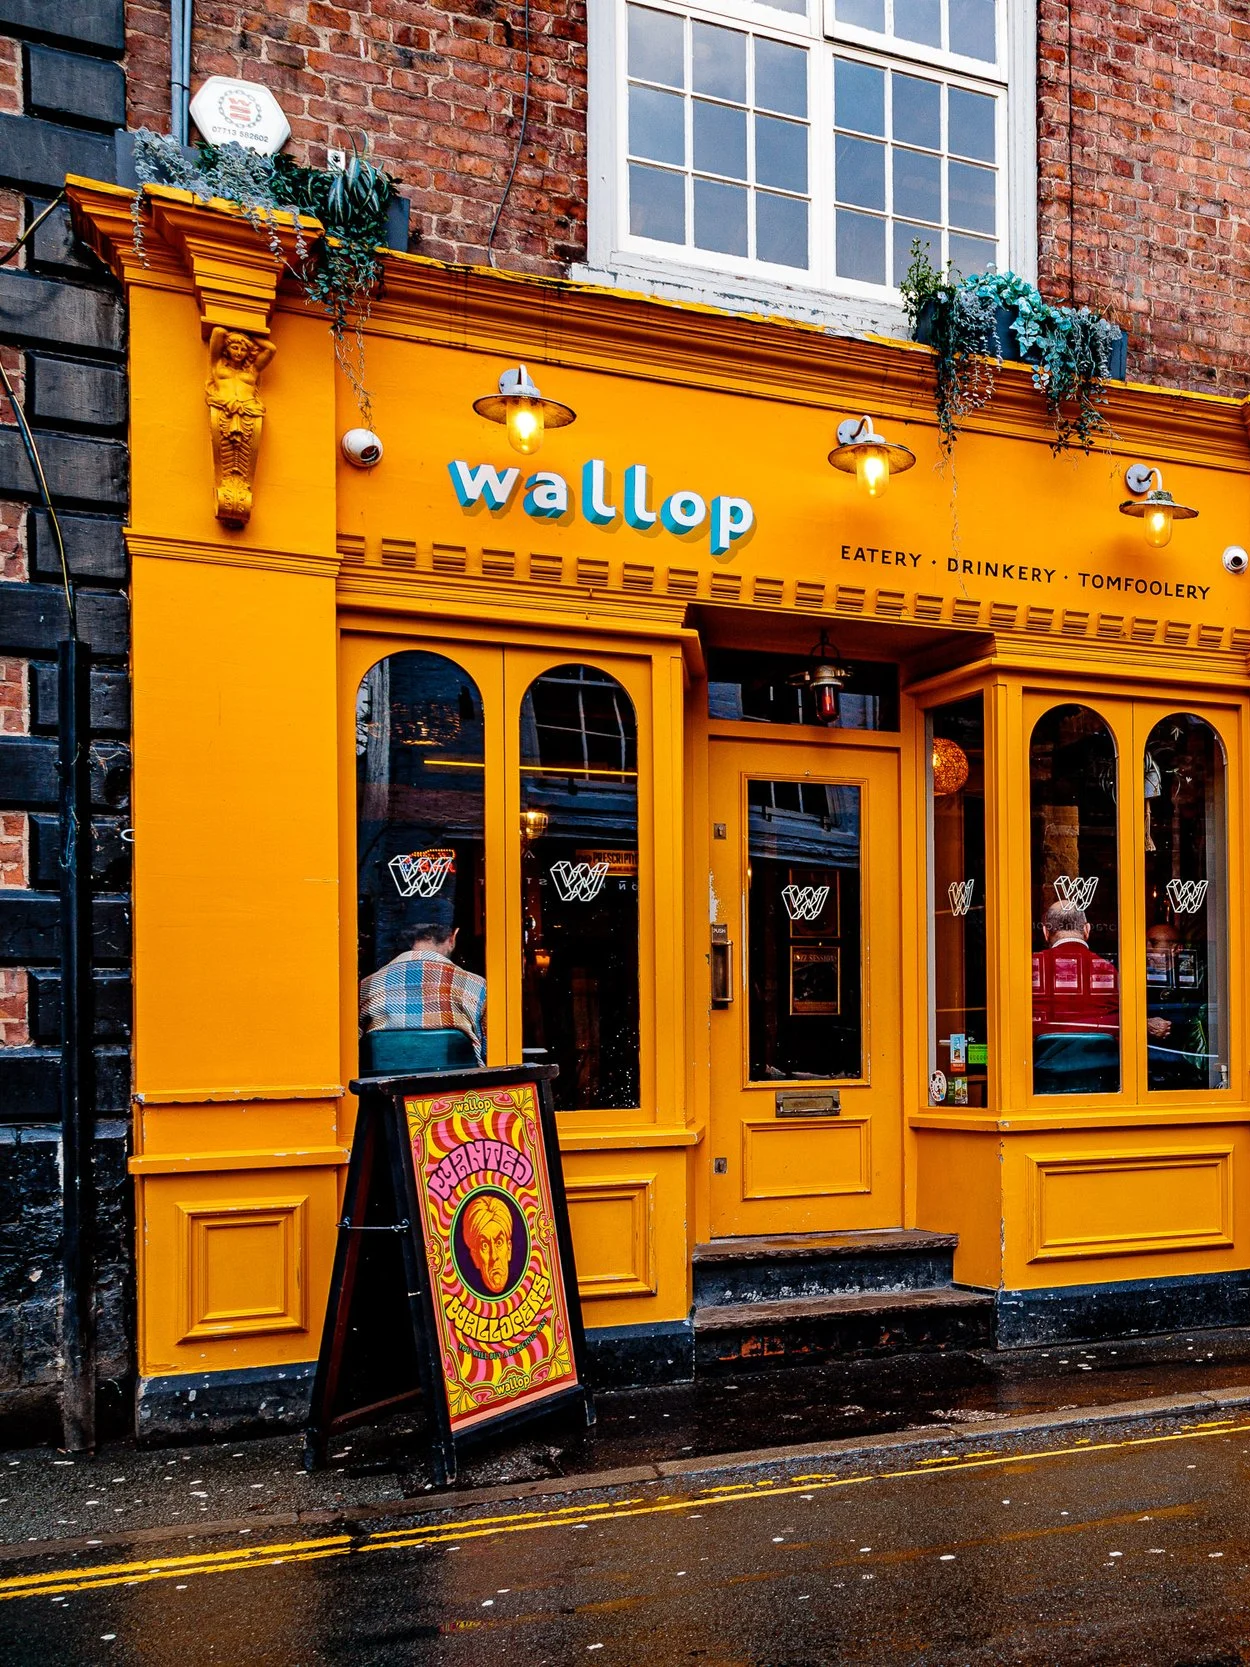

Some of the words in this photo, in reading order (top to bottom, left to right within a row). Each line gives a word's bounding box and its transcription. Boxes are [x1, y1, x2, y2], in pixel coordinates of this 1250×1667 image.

[447, 459, 754, 556] wallop
[840, 544, 922, 568] EATERY
[946, 557, 1056, 584] DRINKERY
[1077, 571, 1211, 600] TOMFOOLERY
[454, 1097, 491, 1113] wallop
[427, 1139, 534, 1201] WANTED
[445, 1273, 550, 1344] WALLOPERS
[458, 1342, 472, 1355] YOU
[472, 1348, 488, 1360] WILL
[489, 1350, 504, 1360] BUY
[508, 1331, 538, 1357] DELICIOUS
[496, 1374, 531, 1396] wallop
